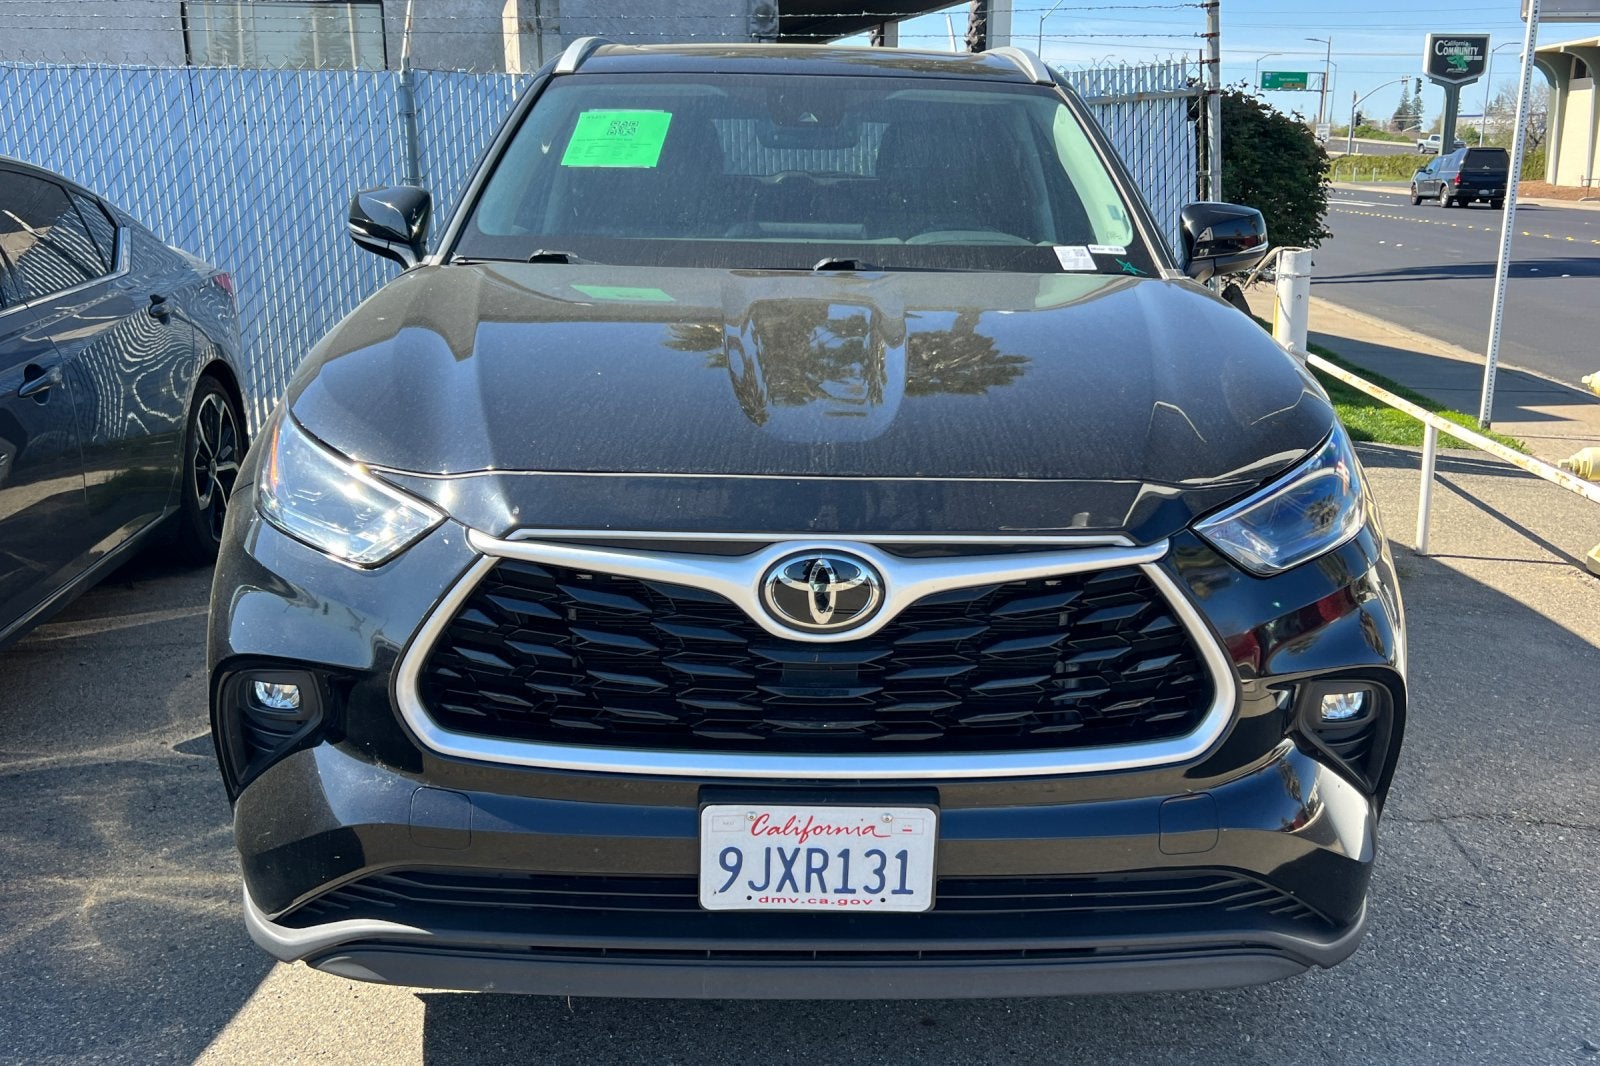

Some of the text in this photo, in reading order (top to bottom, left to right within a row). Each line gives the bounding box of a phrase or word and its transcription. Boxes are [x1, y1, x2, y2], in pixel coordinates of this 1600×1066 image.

[1435, 40, 1479, 56] COMMUNITY
[751, 813, 891, 845] California
[718, 846, 914, 895] 9JXR131
[758, 896, 873, 906] dmv.ca.gov
